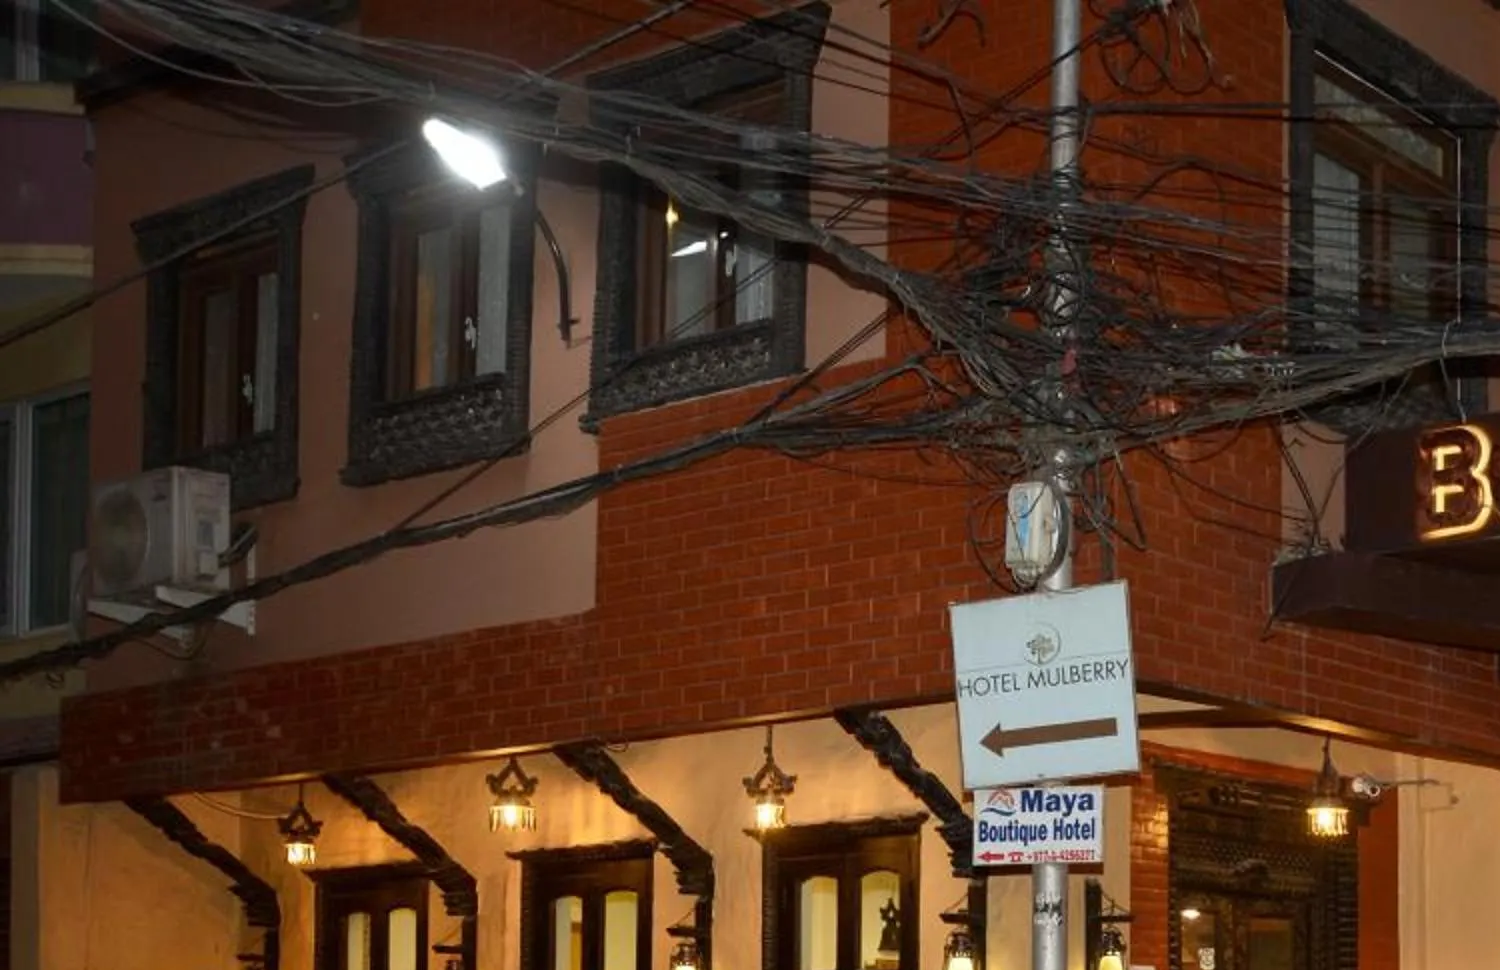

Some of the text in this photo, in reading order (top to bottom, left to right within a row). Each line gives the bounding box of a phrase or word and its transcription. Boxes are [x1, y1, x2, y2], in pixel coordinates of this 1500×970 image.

[958, 659, 1129, 698] HOTEL MULBERRY
[1021, 789, 1094, 817] Maya
[978, 818, 1095, 846] Boutique Hotel
